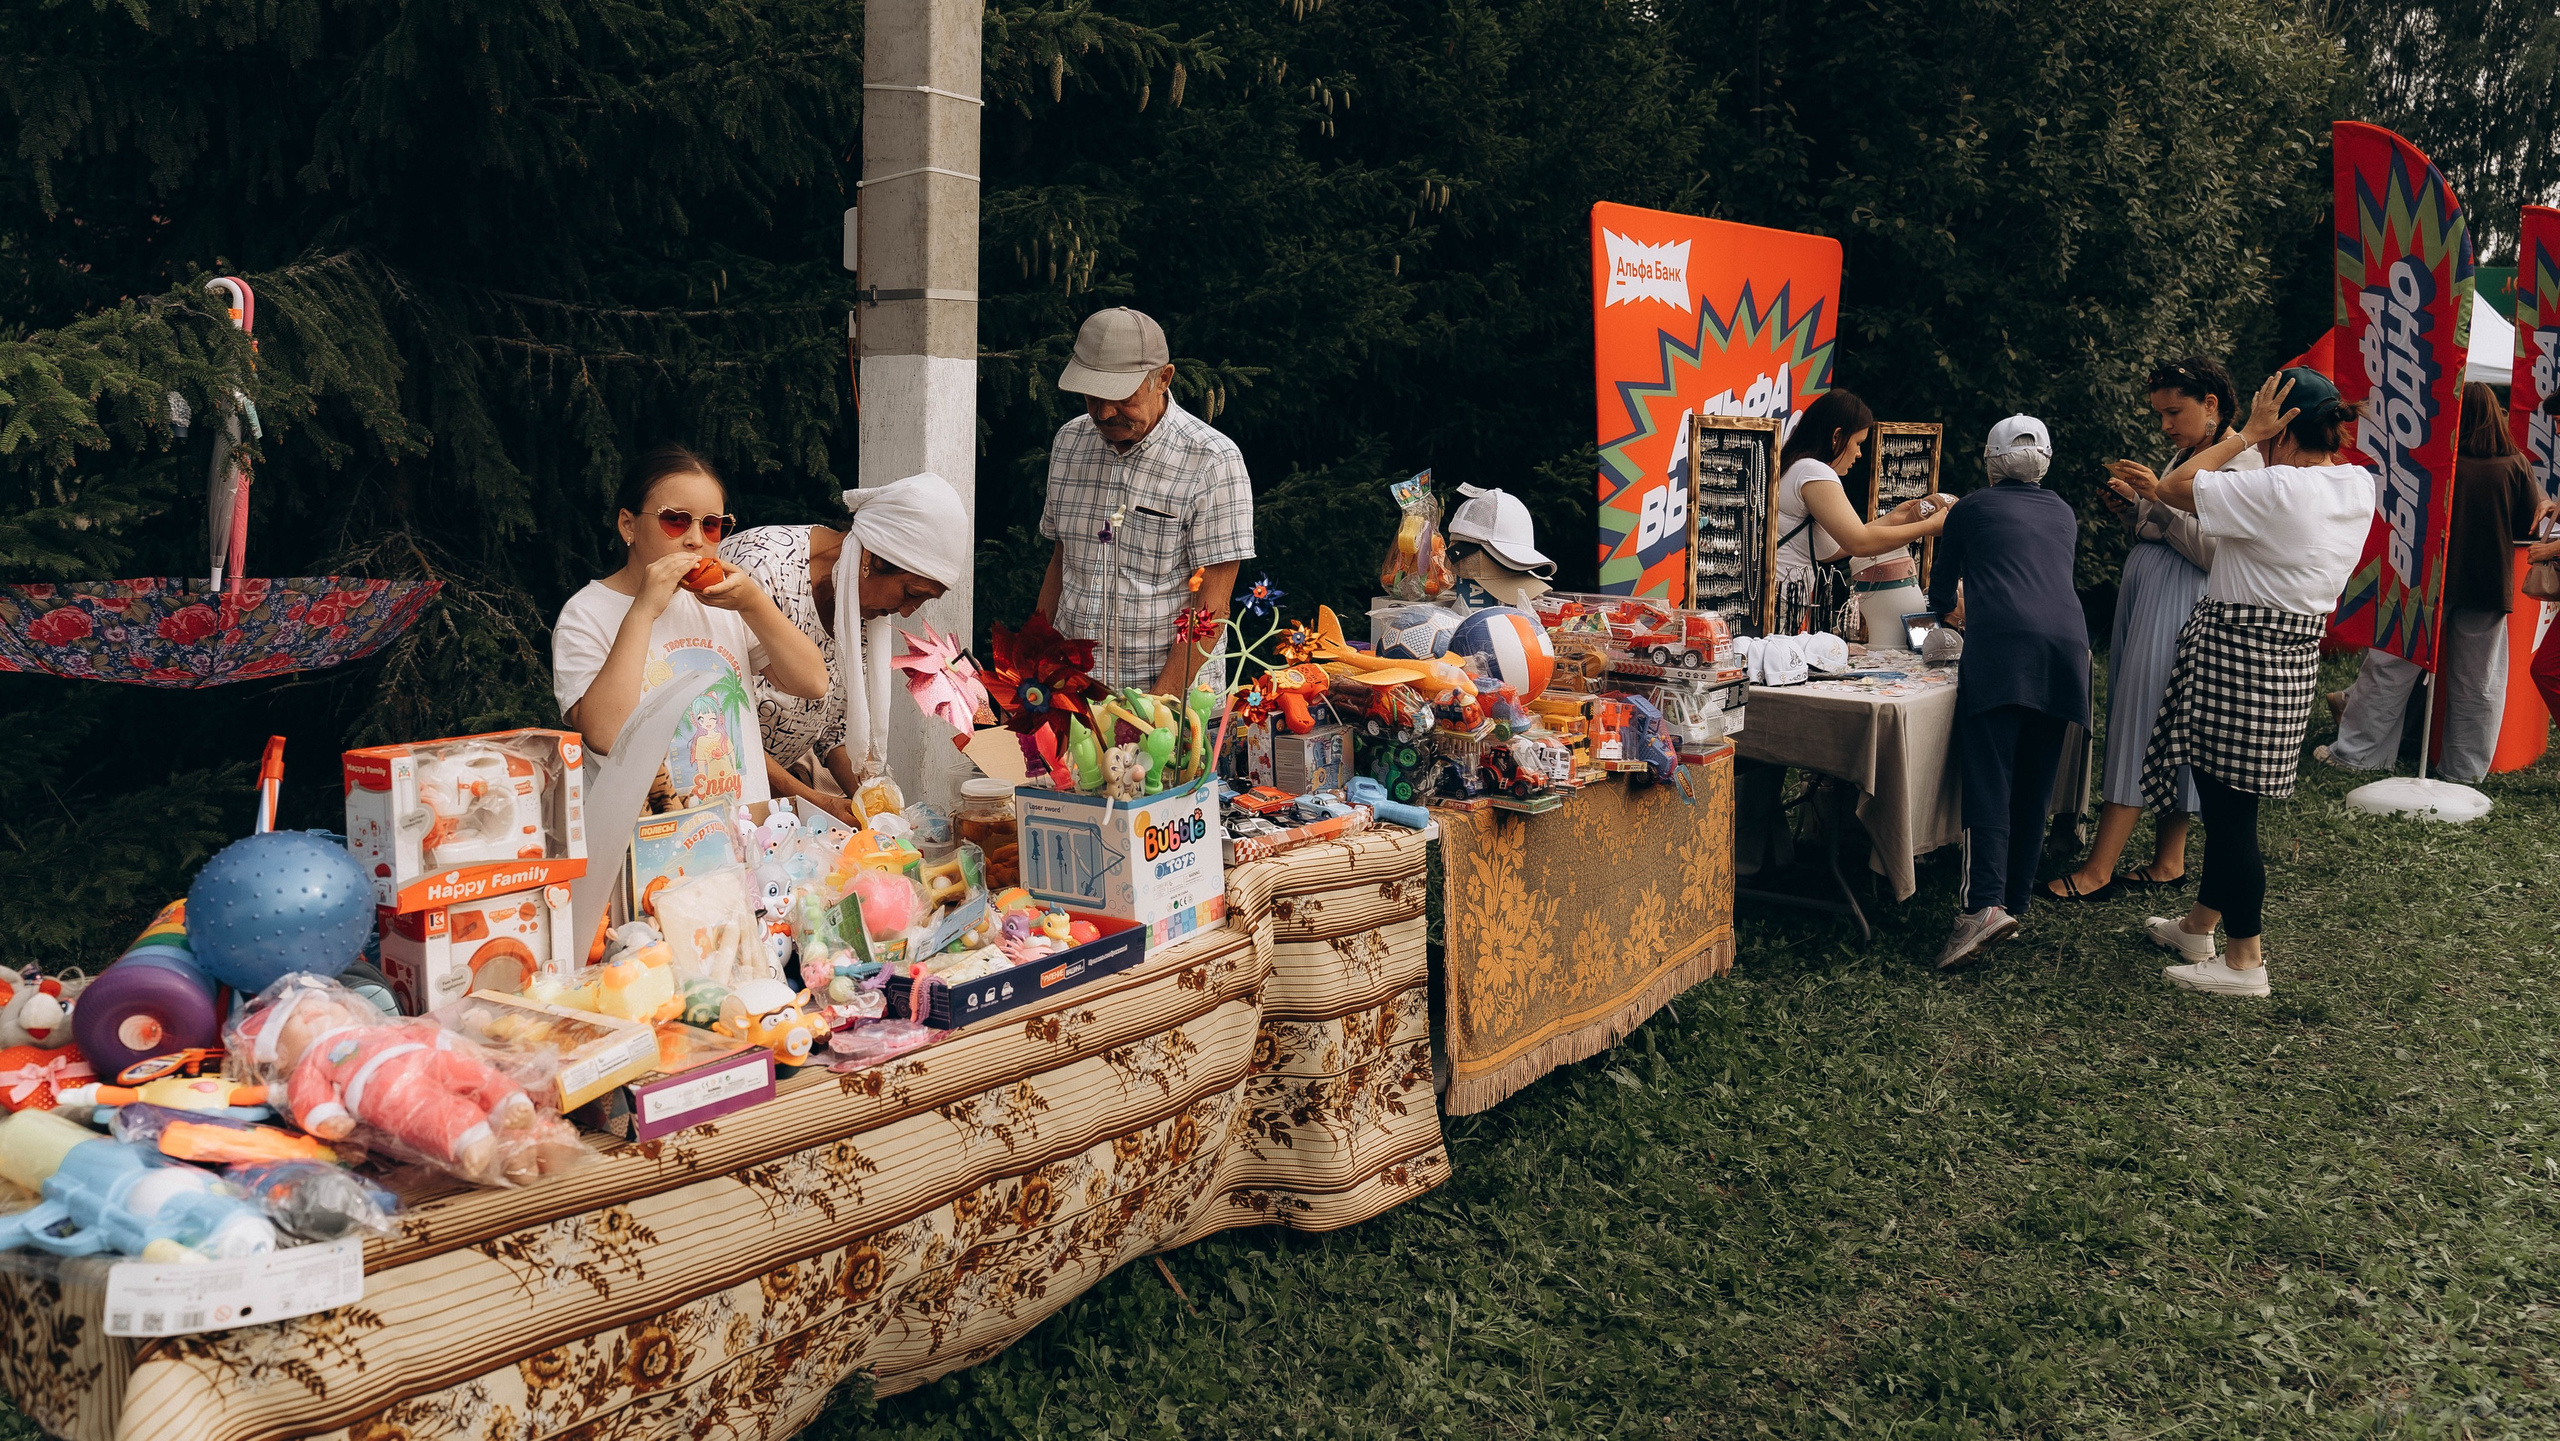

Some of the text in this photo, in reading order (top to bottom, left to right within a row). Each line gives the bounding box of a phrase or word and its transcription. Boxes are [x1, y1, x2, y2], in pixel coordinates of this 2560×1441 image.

[1616, 256, 1681, 283] Альфа Банк
[2387, 260, 2427, 589] ВЫГОДНО
[662, 637, 743, 679] TROPICAL SUNSET
[346, 763, 386, 777] Happy Family
[690, 770, 742, 801] Enjoy
[1028, 803, 1044, 811] Laser
[640, 823, 676, 837] ПОЛЕСЬЕ
[1144, 814, 1206, 862] Bubble
[1166, 853, 1195, 873] TOYS
[428, 878, 487, 900] Happy
[491, 866, 549, 888] Family
